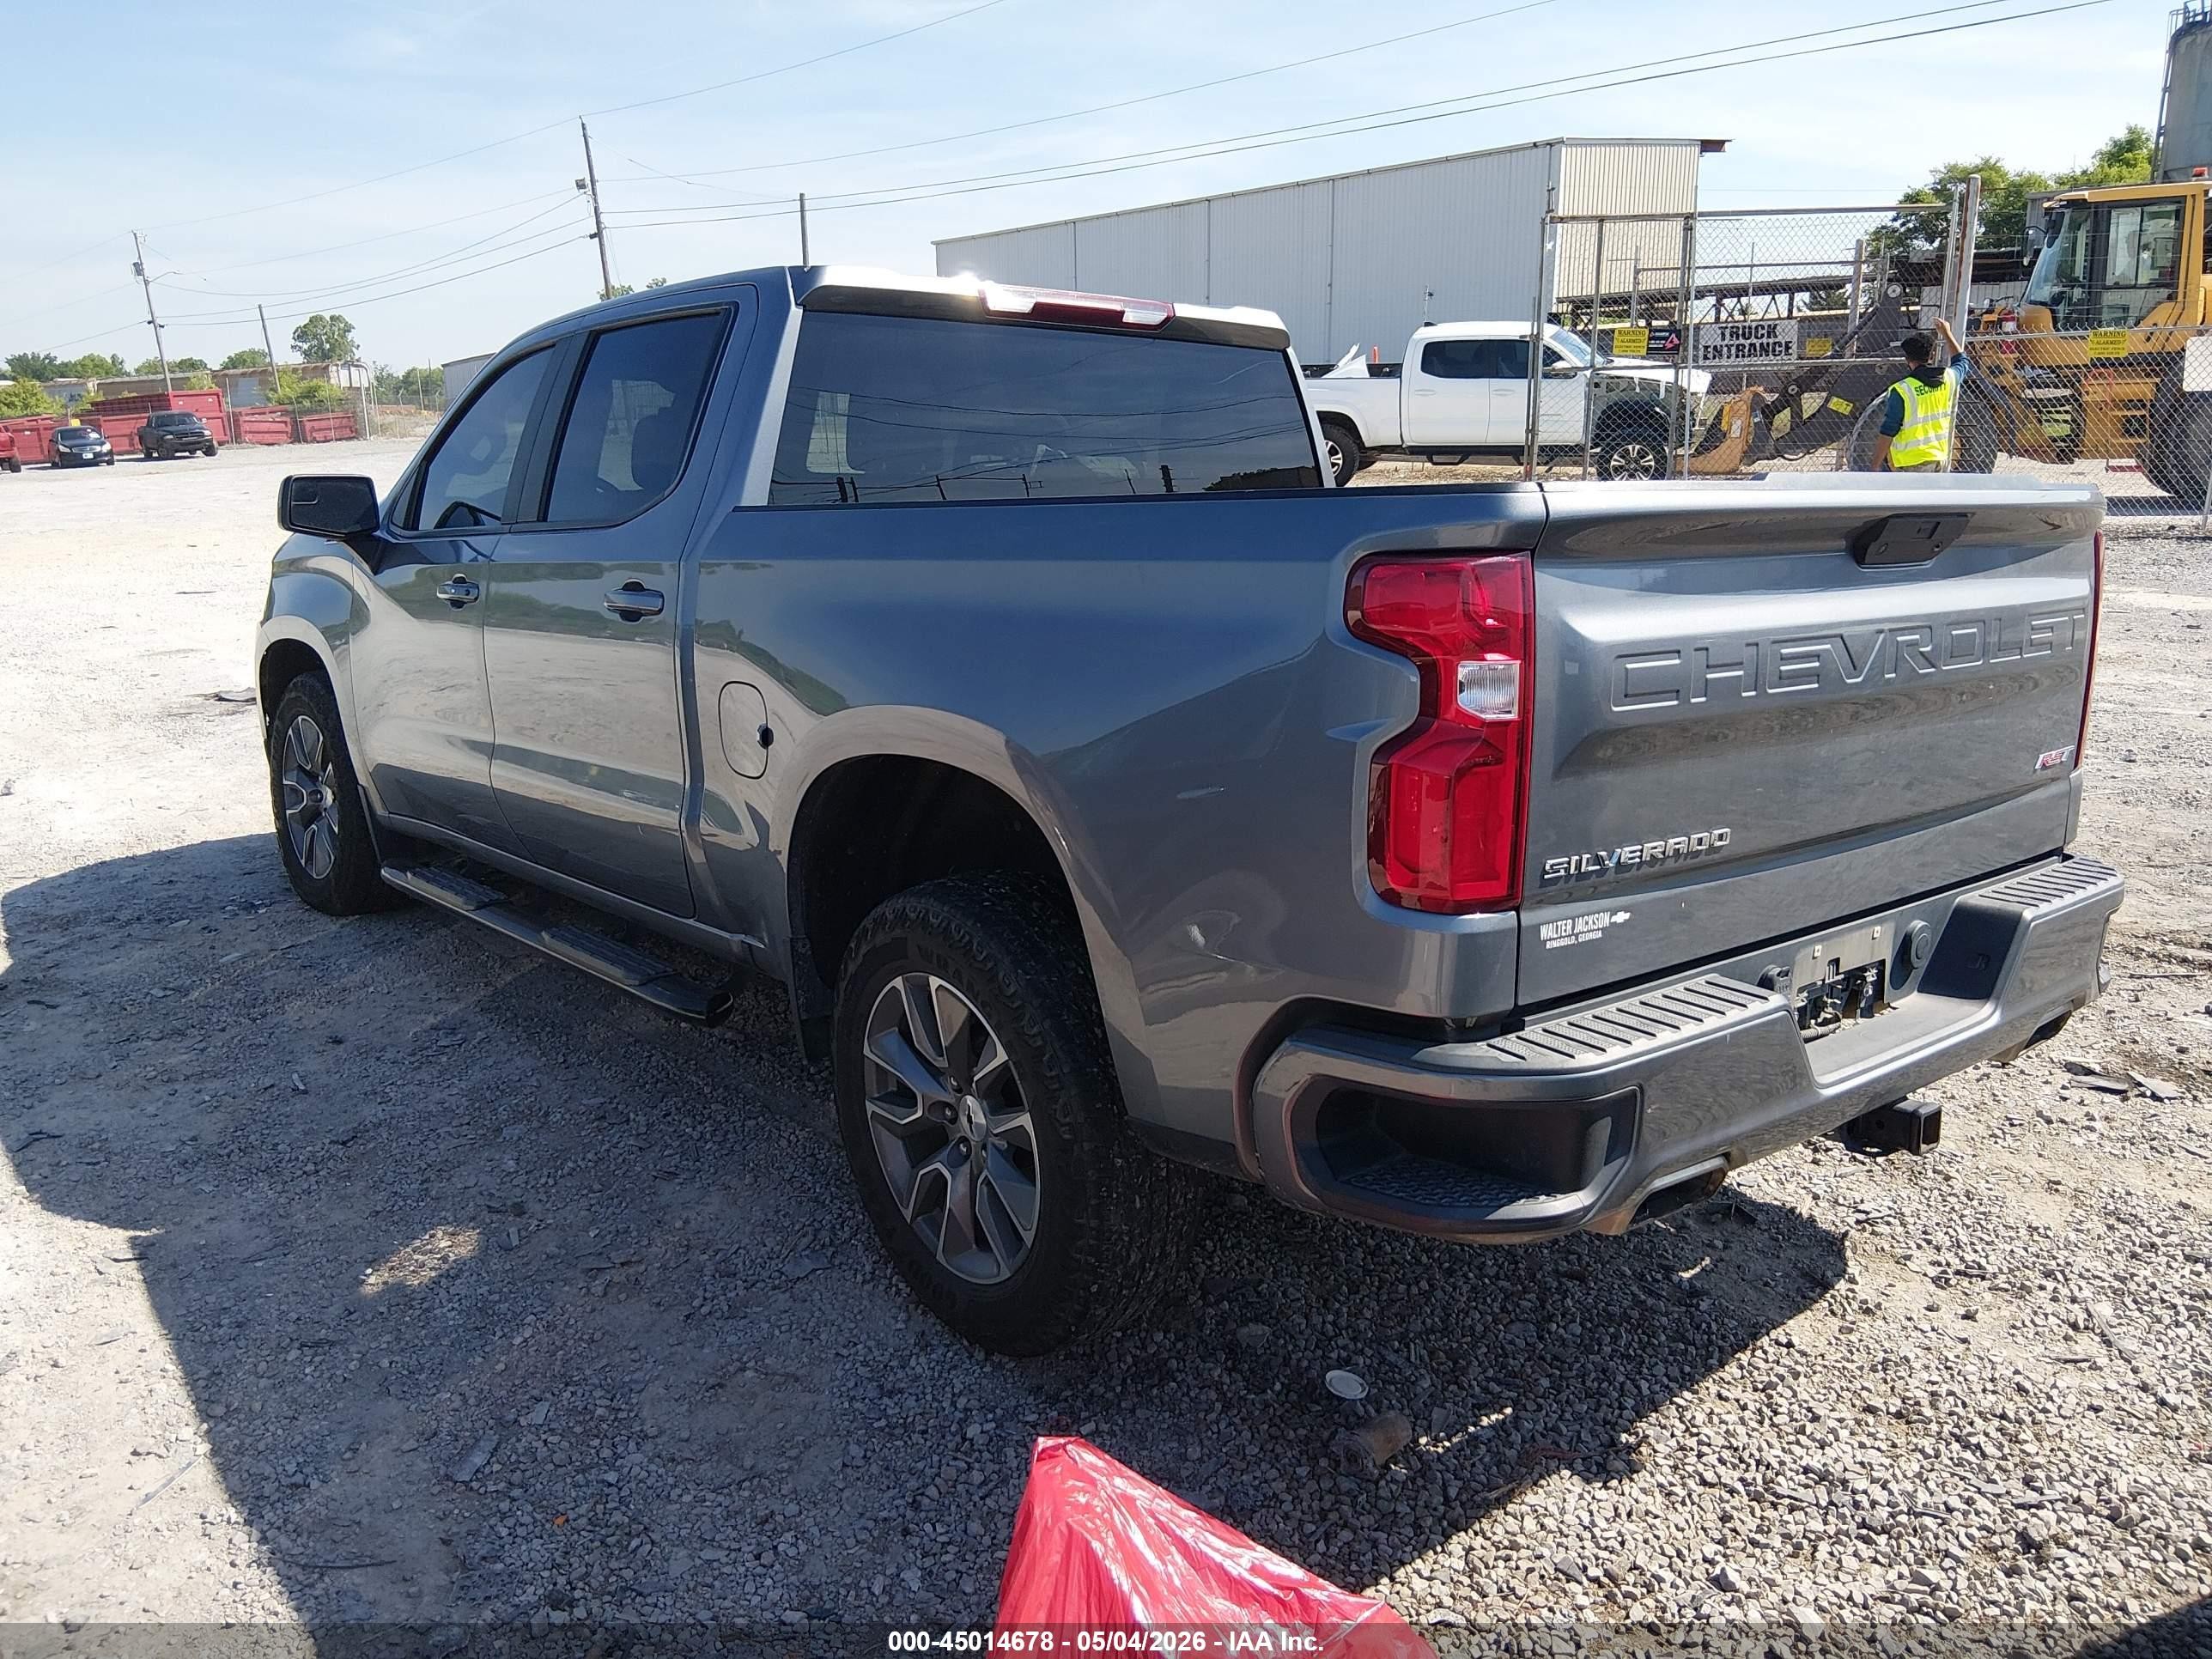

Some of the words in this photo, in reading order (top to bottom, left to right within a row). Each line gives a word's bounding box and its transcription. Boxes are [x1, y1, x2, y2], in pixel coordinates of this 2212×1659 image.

[1717, 324, 1779, 341] TRUCK
[1703, 341, 1793, 361] ENTRANCE
[1610, 607, 2086, 713] CHEVROLET
[1543, 827, 1731, 879] SILVERADO
[1540, 919, 1573, 941] WALTER
[1573, 911, 1611, 934] JACKSON
[1546, 935, 1577, 950] RINGGOLD,
[1578, 929, 1602, 942] GEORGIA
